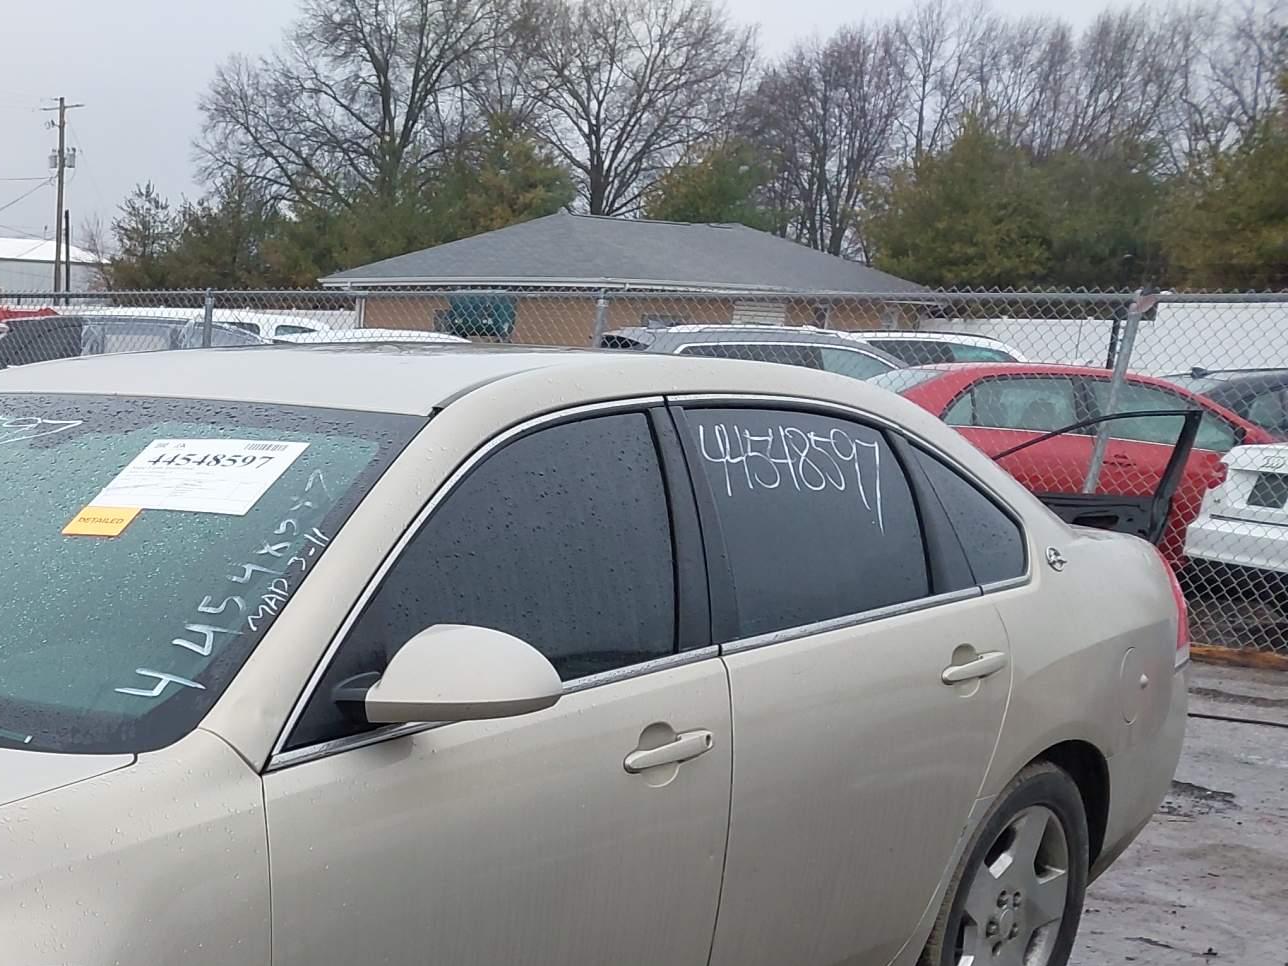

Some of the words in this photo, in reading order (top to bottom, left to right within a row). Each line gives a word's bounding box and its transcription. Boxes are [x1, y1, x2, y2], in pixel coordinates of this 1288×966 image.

[147, 452, 276, 469] 44548597
[699, 423, 886, 536] 44548597
[77, 516, 125, 526] DETAILED
[287, 527, 330, 571] 3-11
